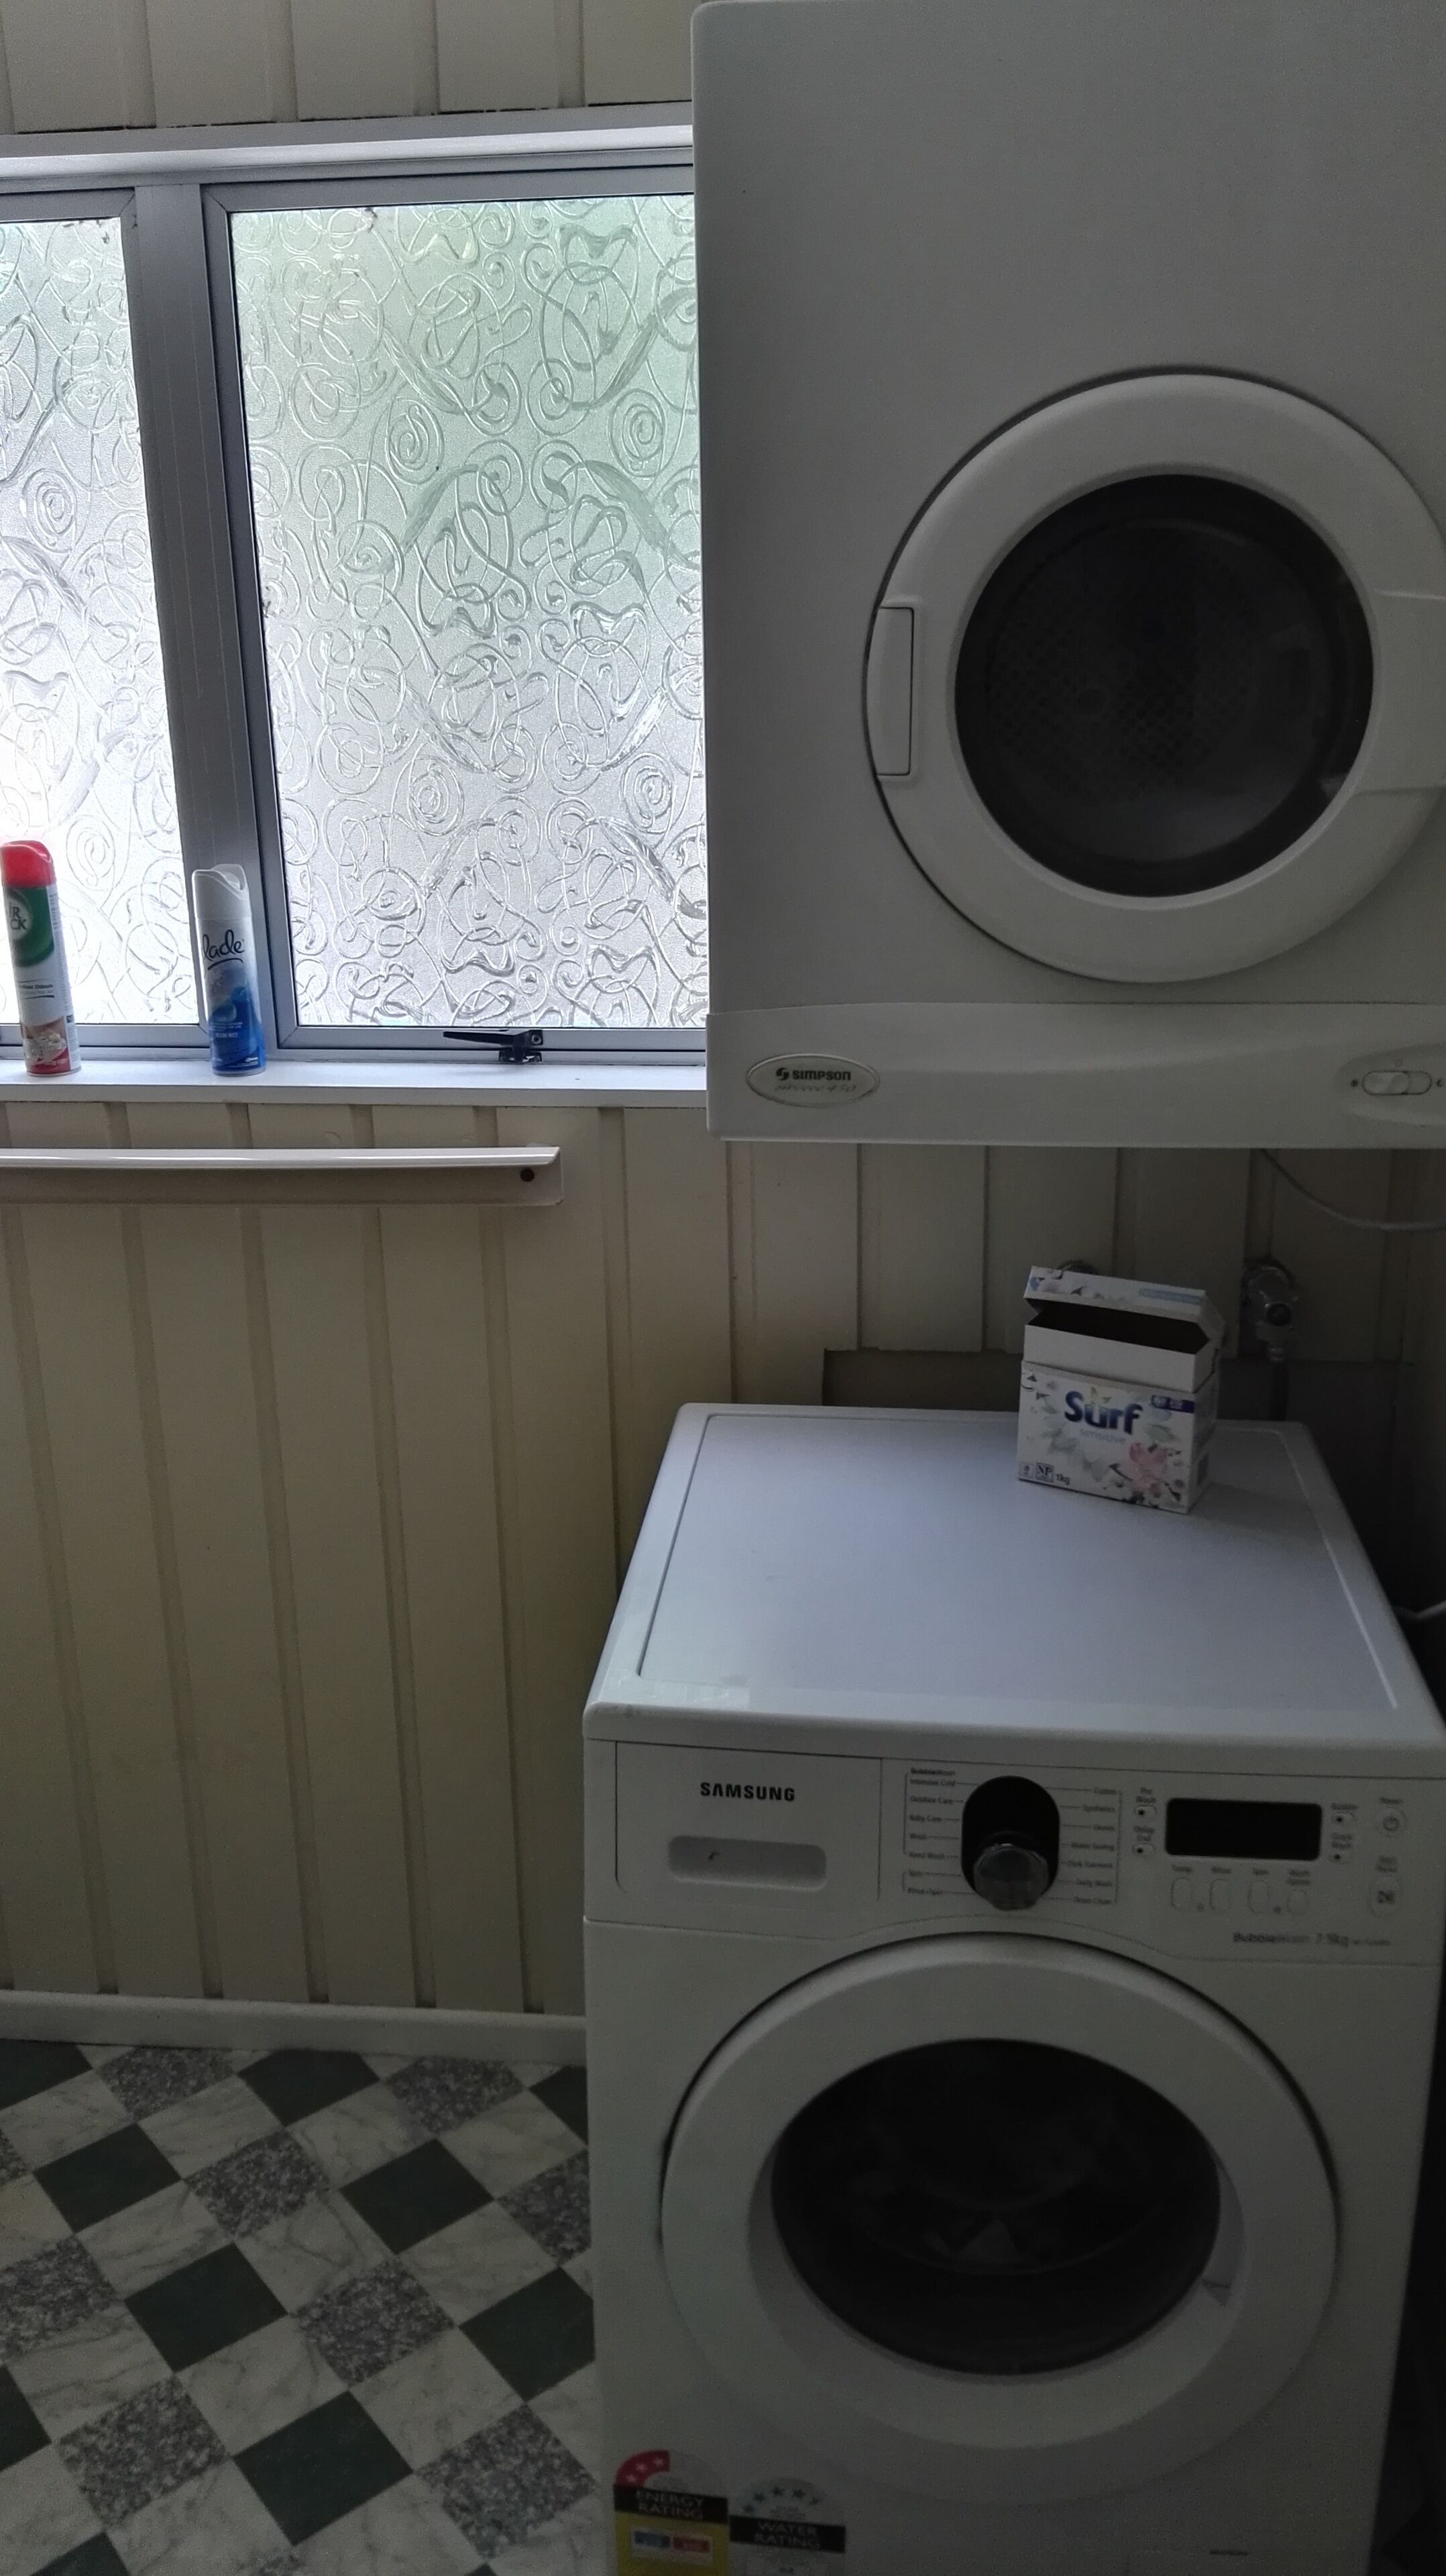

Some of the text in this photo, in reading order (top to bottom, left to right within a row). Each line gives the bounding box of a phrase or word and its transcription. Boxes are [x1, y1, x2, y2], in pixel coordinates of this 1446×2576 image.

[203, 929, 245, 962] lade
[792, 1070, 851, 1081] SIMPSON
[1064, 1391, 1143, 1436] Surf
[700, 1782, 795, 1802] SAMSUNG
[635, 2489, 704, 2508] ENERGY
[638, 2502, 704, 2520] RATING
[758, 2521, 818, 2538] WATER
